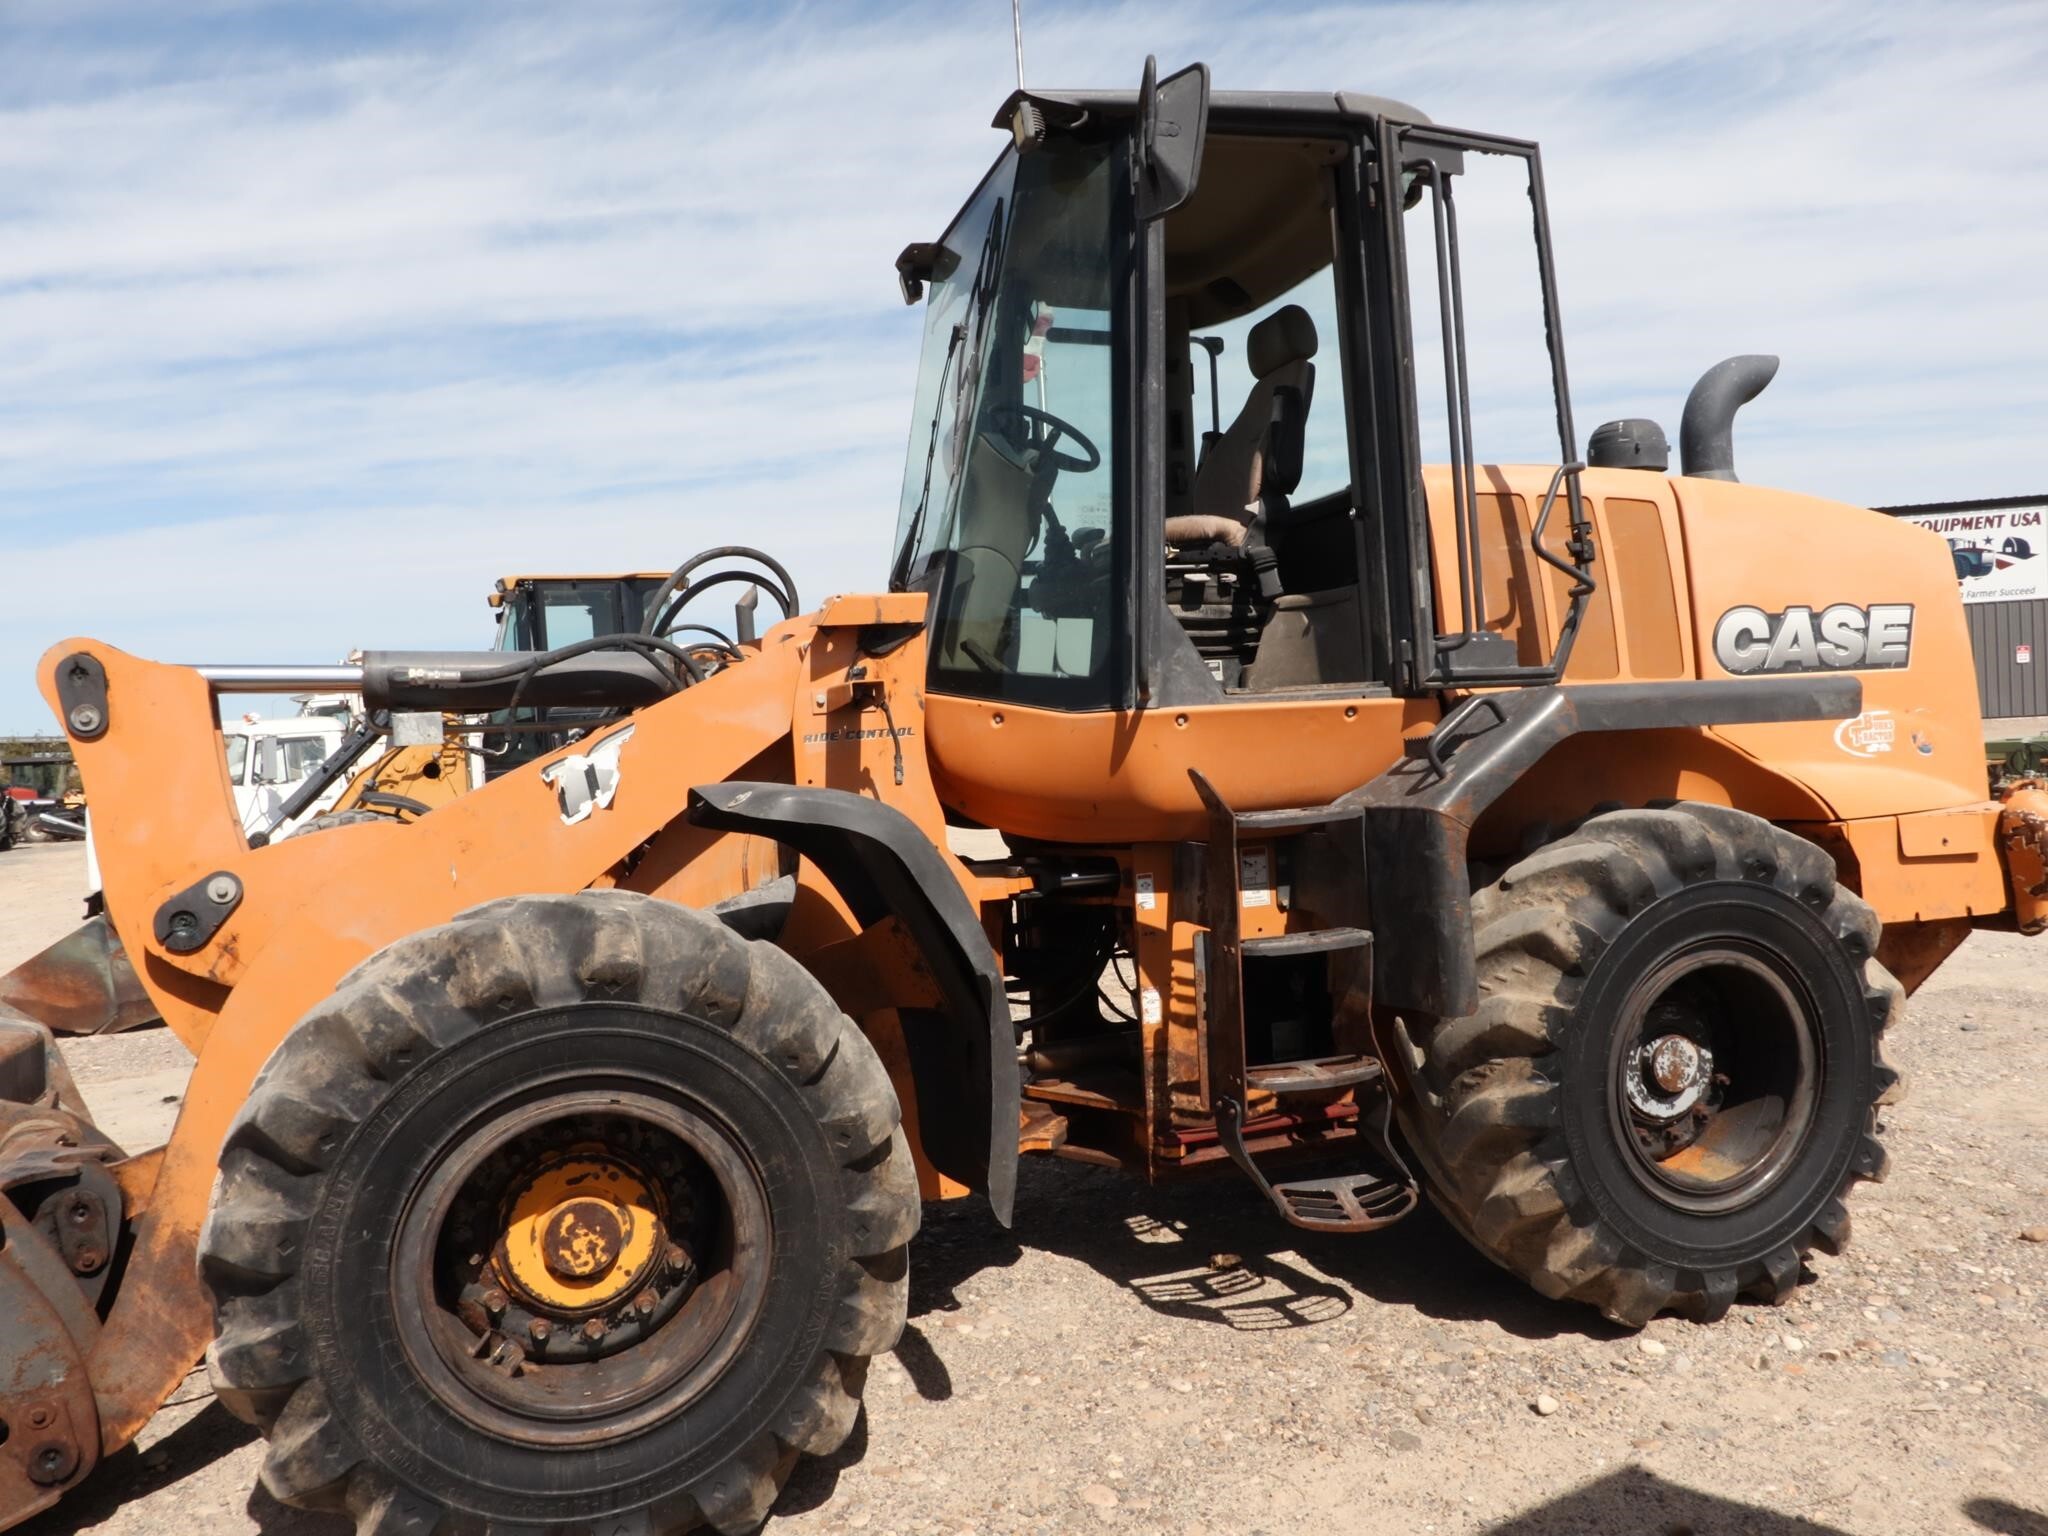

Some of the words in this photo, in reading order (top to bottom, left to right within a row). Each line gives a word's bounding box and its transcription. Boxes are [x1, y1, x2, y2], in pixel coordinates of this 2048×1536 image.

[1912, 514, 2006, 533] QUIPMENT
[2010, 511, 2042, 527] USA
[1966, 589, 1997, 599] Farmer
[1999, 586, 2036, 597] Succeed
[1715, 605, 1913, 674] CASE
[802, 731, 839, 744] RIDE
